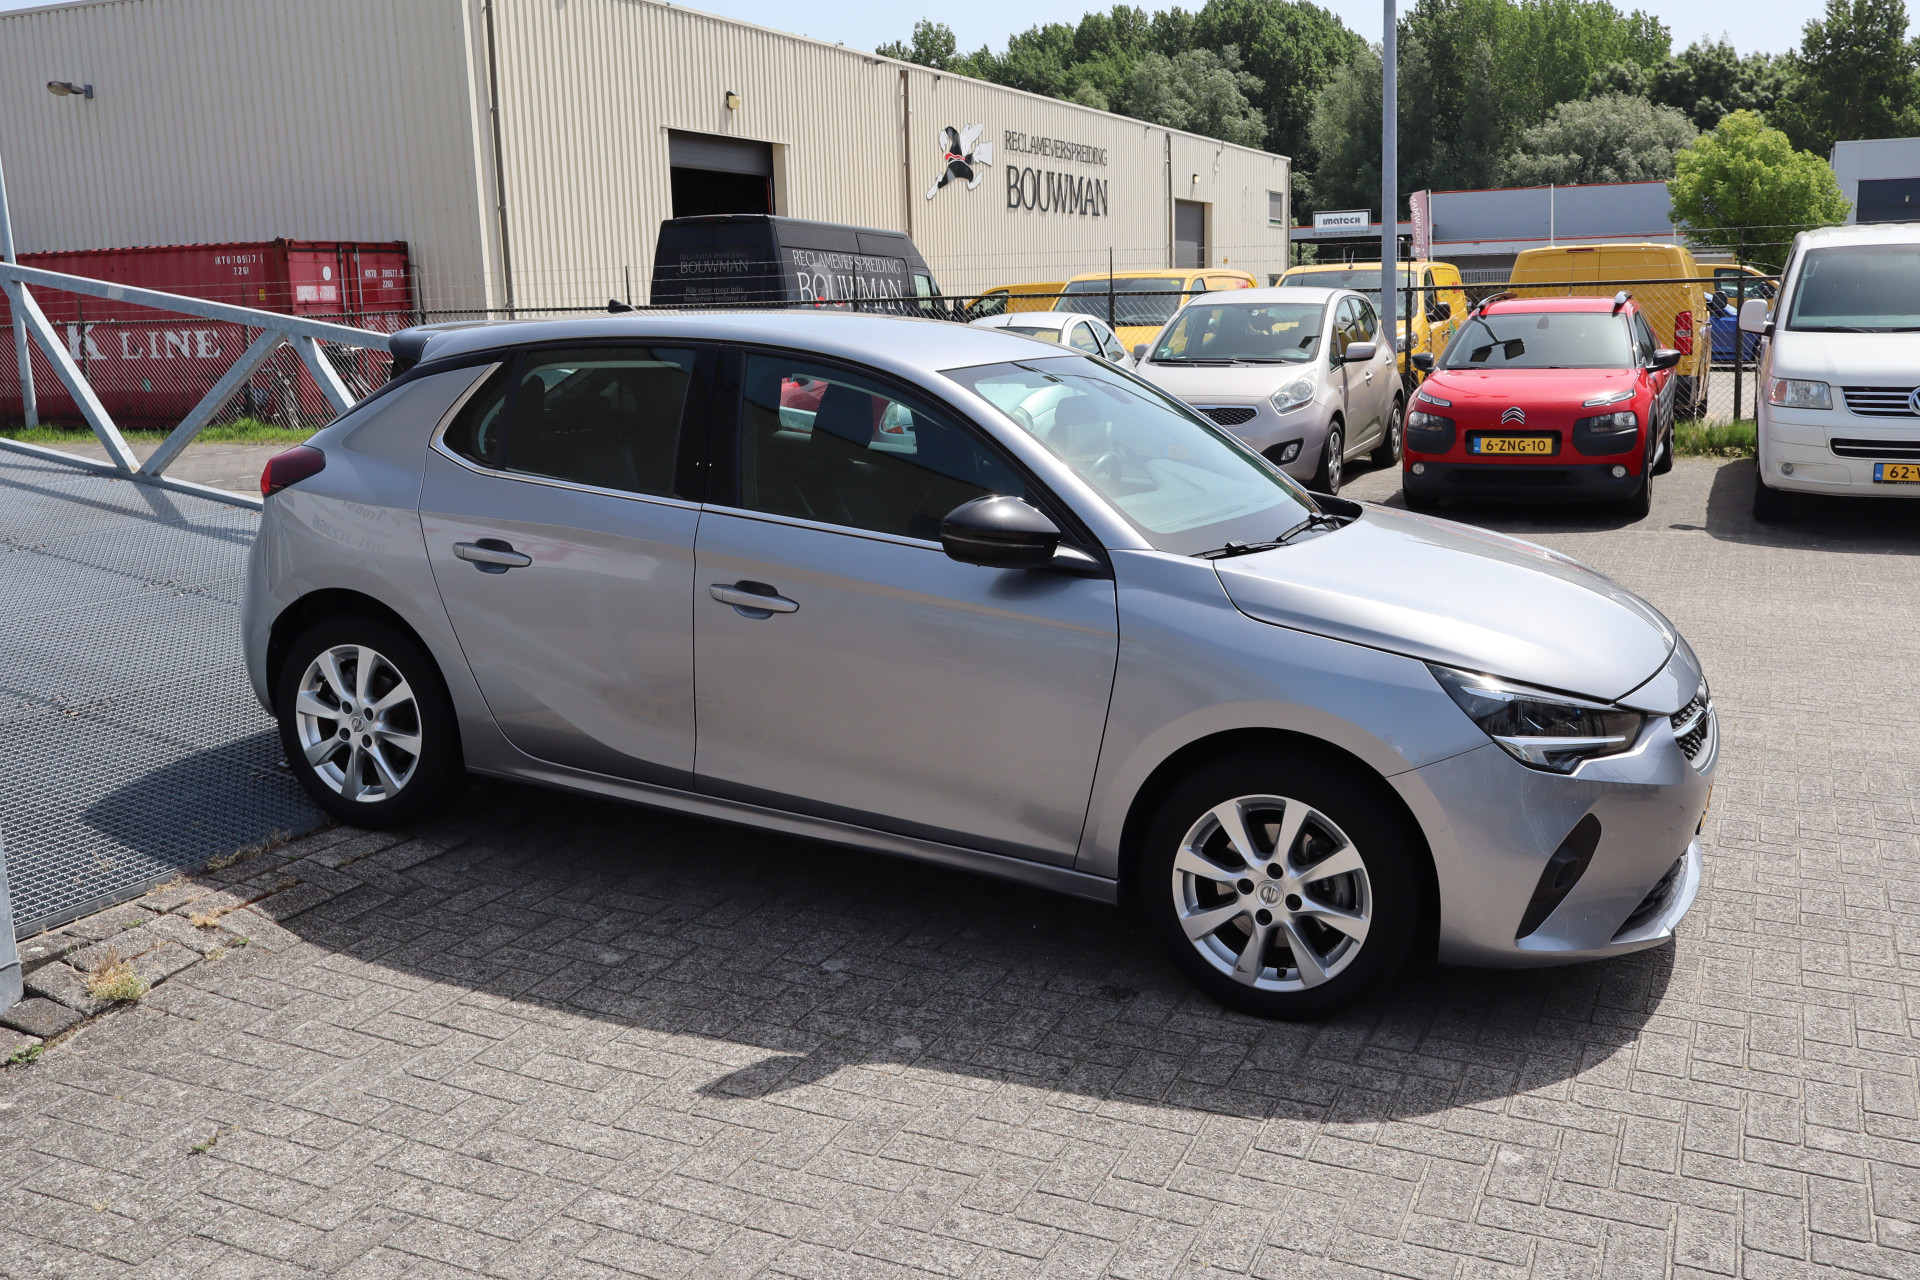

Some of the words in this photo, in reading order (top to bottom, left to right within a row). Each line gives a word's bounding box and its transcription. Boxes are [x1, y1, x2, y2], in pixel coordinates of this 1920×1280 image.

[1005, 130, 1107, 166] RECLAMEVERSPREIDING
[1007, 165, 1107, 216] BOUWMAN
[680, 260, 749, 274] BOUWMAN
[792, 249, 900, 274] RECLAMEVERSPREIDING
[797, 272, 903, 310] BOUWMAN
[119, 329, 222, 360] LINE
[1486, 440, 1546, 451] 6-ZNG-10
